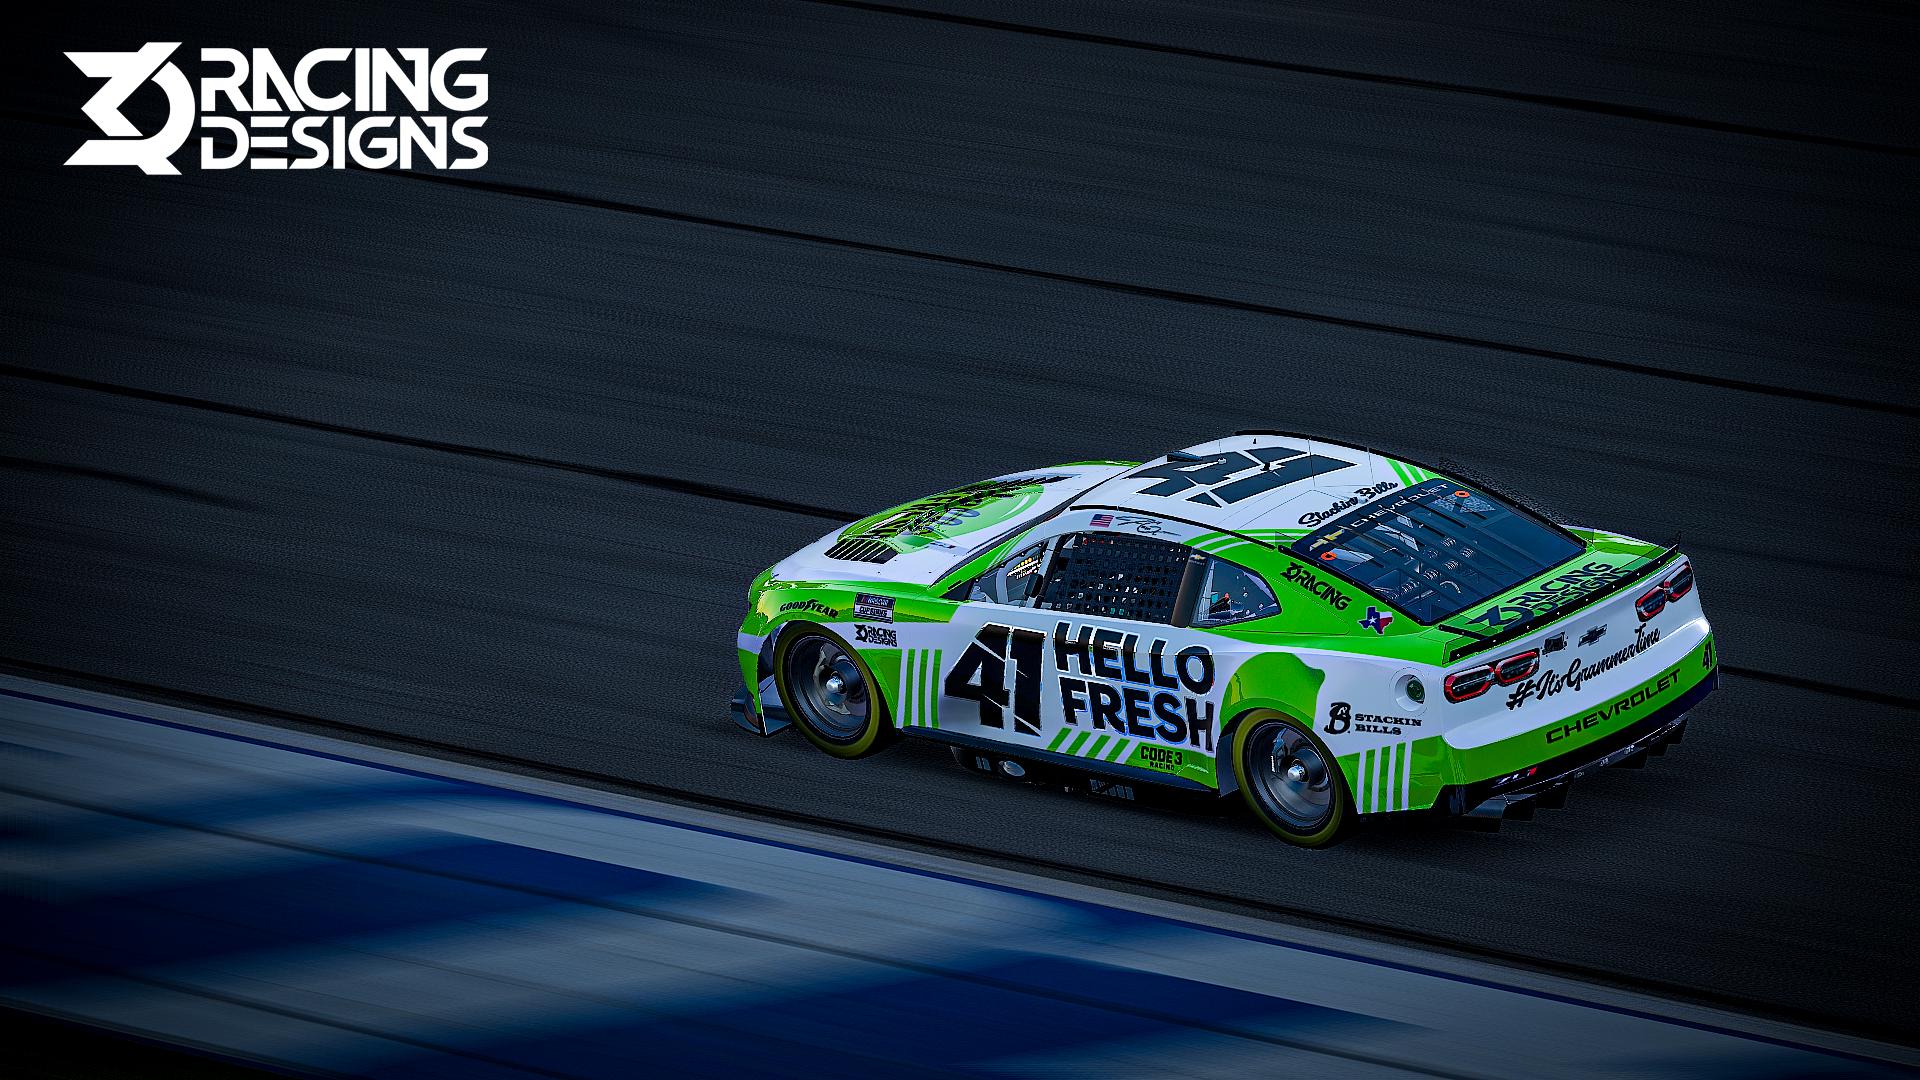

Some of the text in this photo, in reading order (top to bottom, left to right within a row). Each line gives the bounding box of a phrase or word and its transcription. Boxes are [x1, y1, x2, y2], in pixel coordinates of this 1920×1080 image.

[1297, 568, 1352, 611] RACING
[1506, 561, 1613, 608] RACING
[780, 599, 838, 618] GOODYEAR
[867, 626, 897, 639] RACING
[867, 636, 898, 647] DESIGNS
[944, 622, 1047, 737] 41
[1053, 621, 1215, 695] HELLO
[1058, 676, 1215, 751] FRESH
[1355, 713, 1422, 727] STACKIN
[1546, 668, 1681, 744] CHEVROLET
[1355, 724, 1402, 735] BILLS
